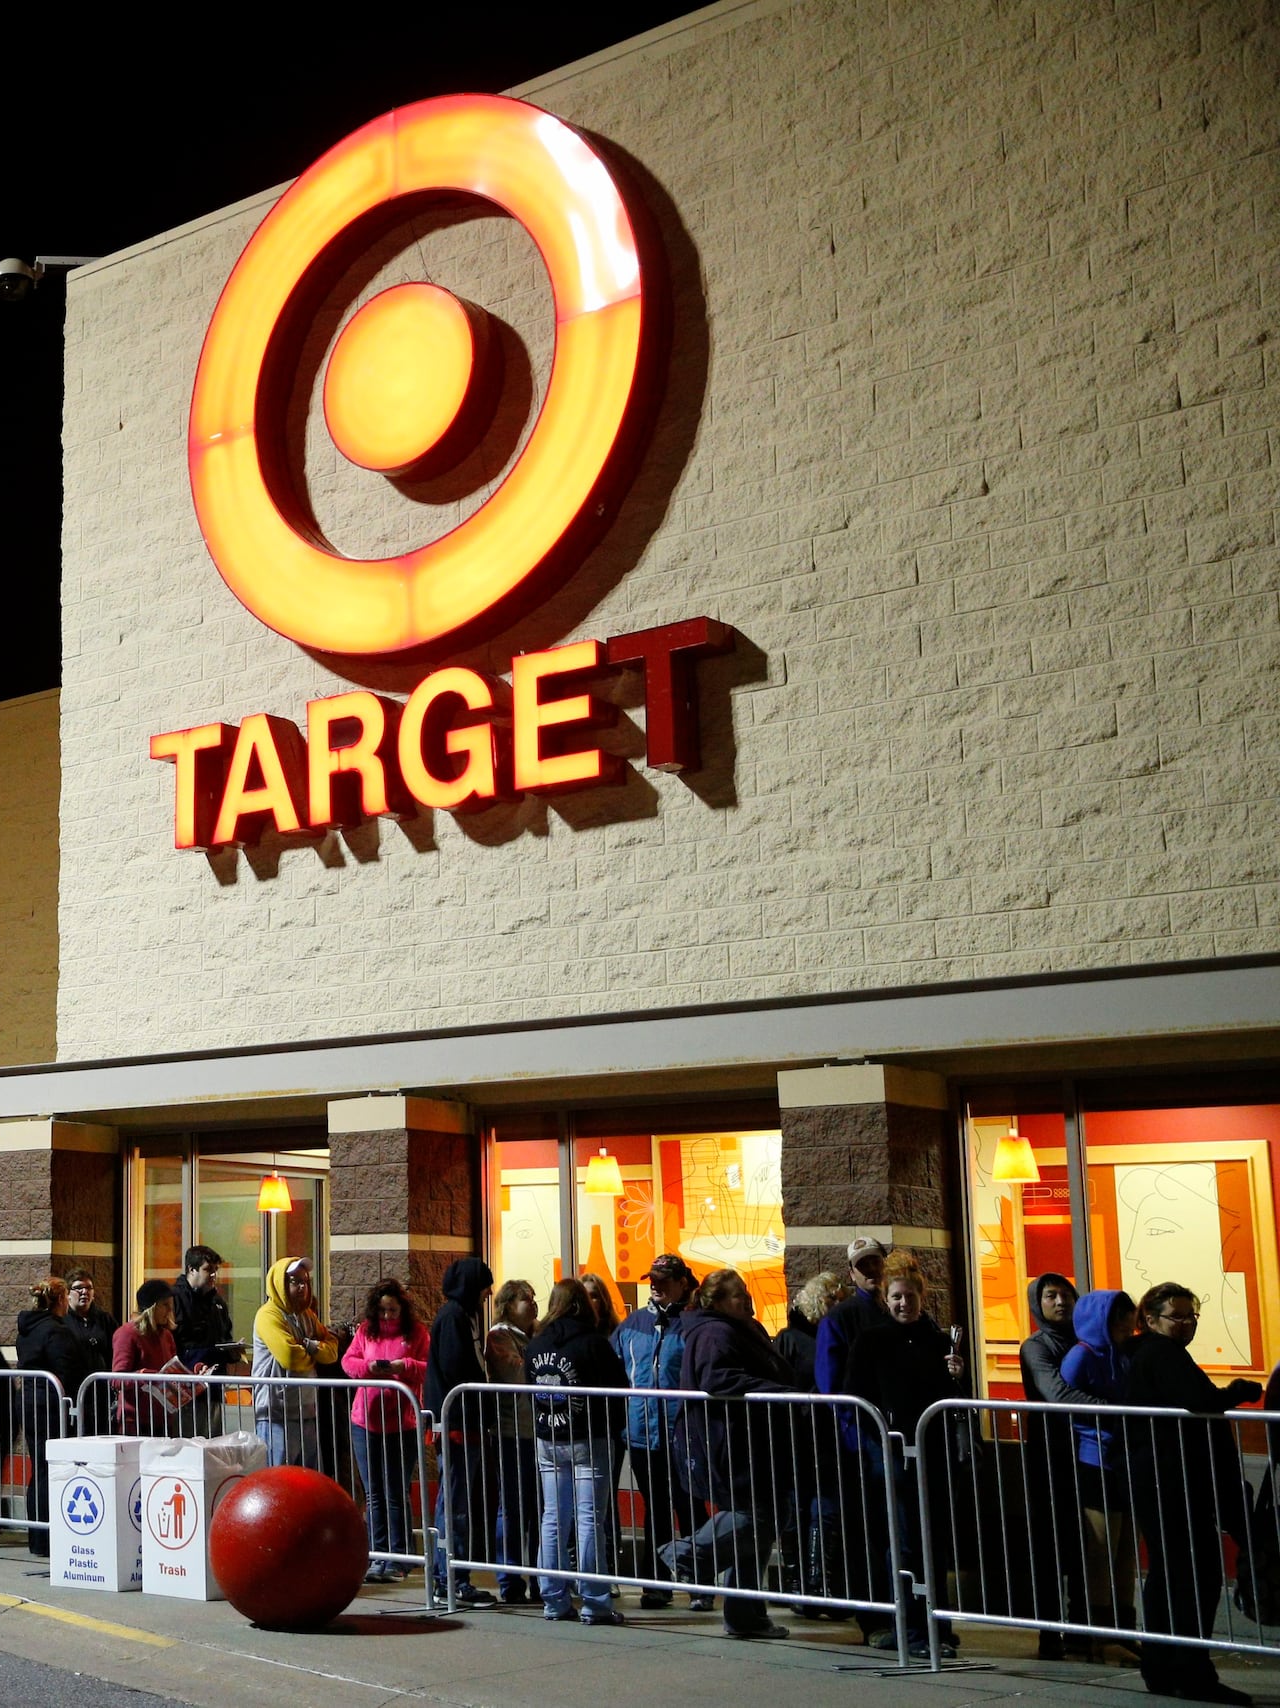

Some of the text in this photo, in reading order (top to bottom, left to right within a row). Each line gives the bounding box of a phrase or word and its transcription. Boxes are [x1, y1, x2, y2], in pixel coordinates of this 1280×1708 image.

[150, 616, 728, 851] TARGET
[71, 1545, 95, 1556] Glass
[69, 1558, 98, 1569] Plastic
[158, 1562, 186, 1577] Trash
[63, 1570, 105, 1583] Aluminum
